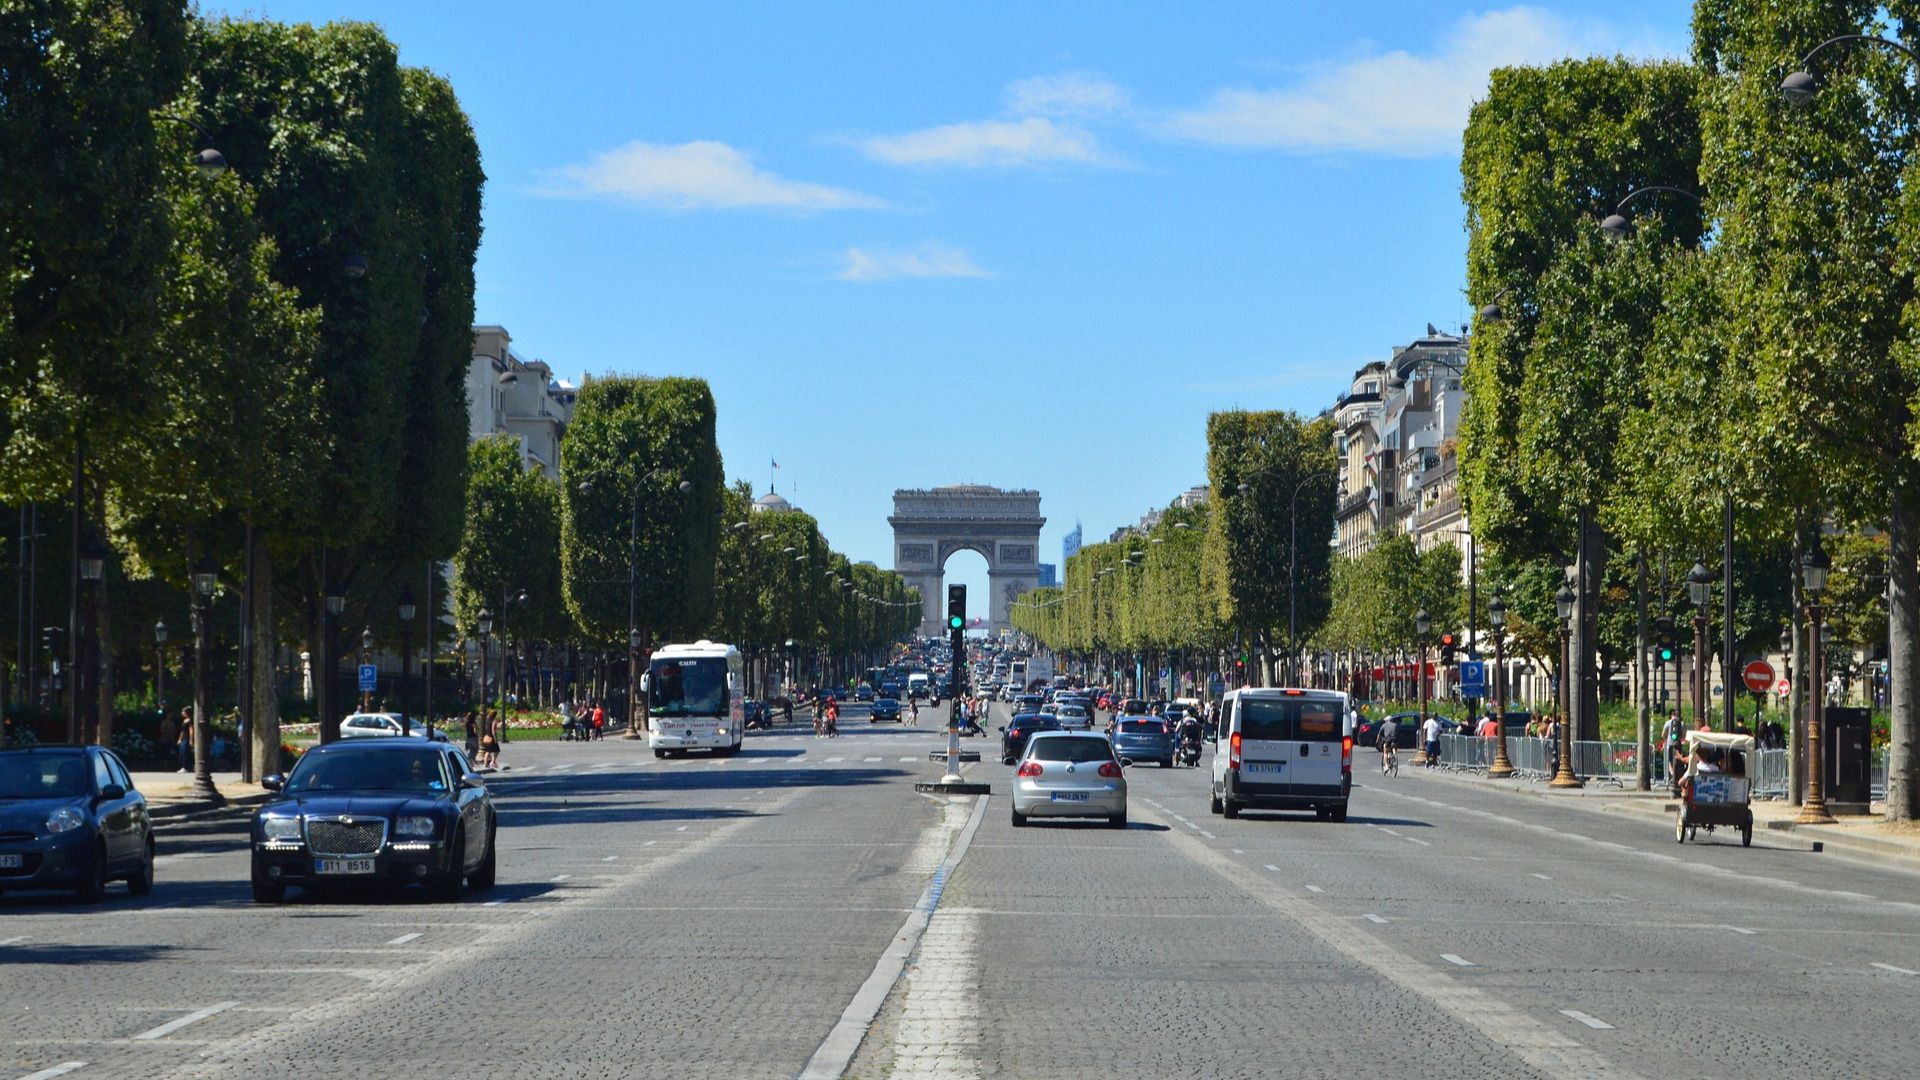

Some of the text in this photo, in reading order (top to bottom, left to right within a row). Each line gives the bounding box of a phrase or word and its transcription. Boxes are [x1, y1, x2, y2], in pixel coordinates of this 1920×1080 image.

[364, 668, 372, 679] P
[1468, 665, 1478, 679] P
[323, 861, 370, 872] 9T1 8516
